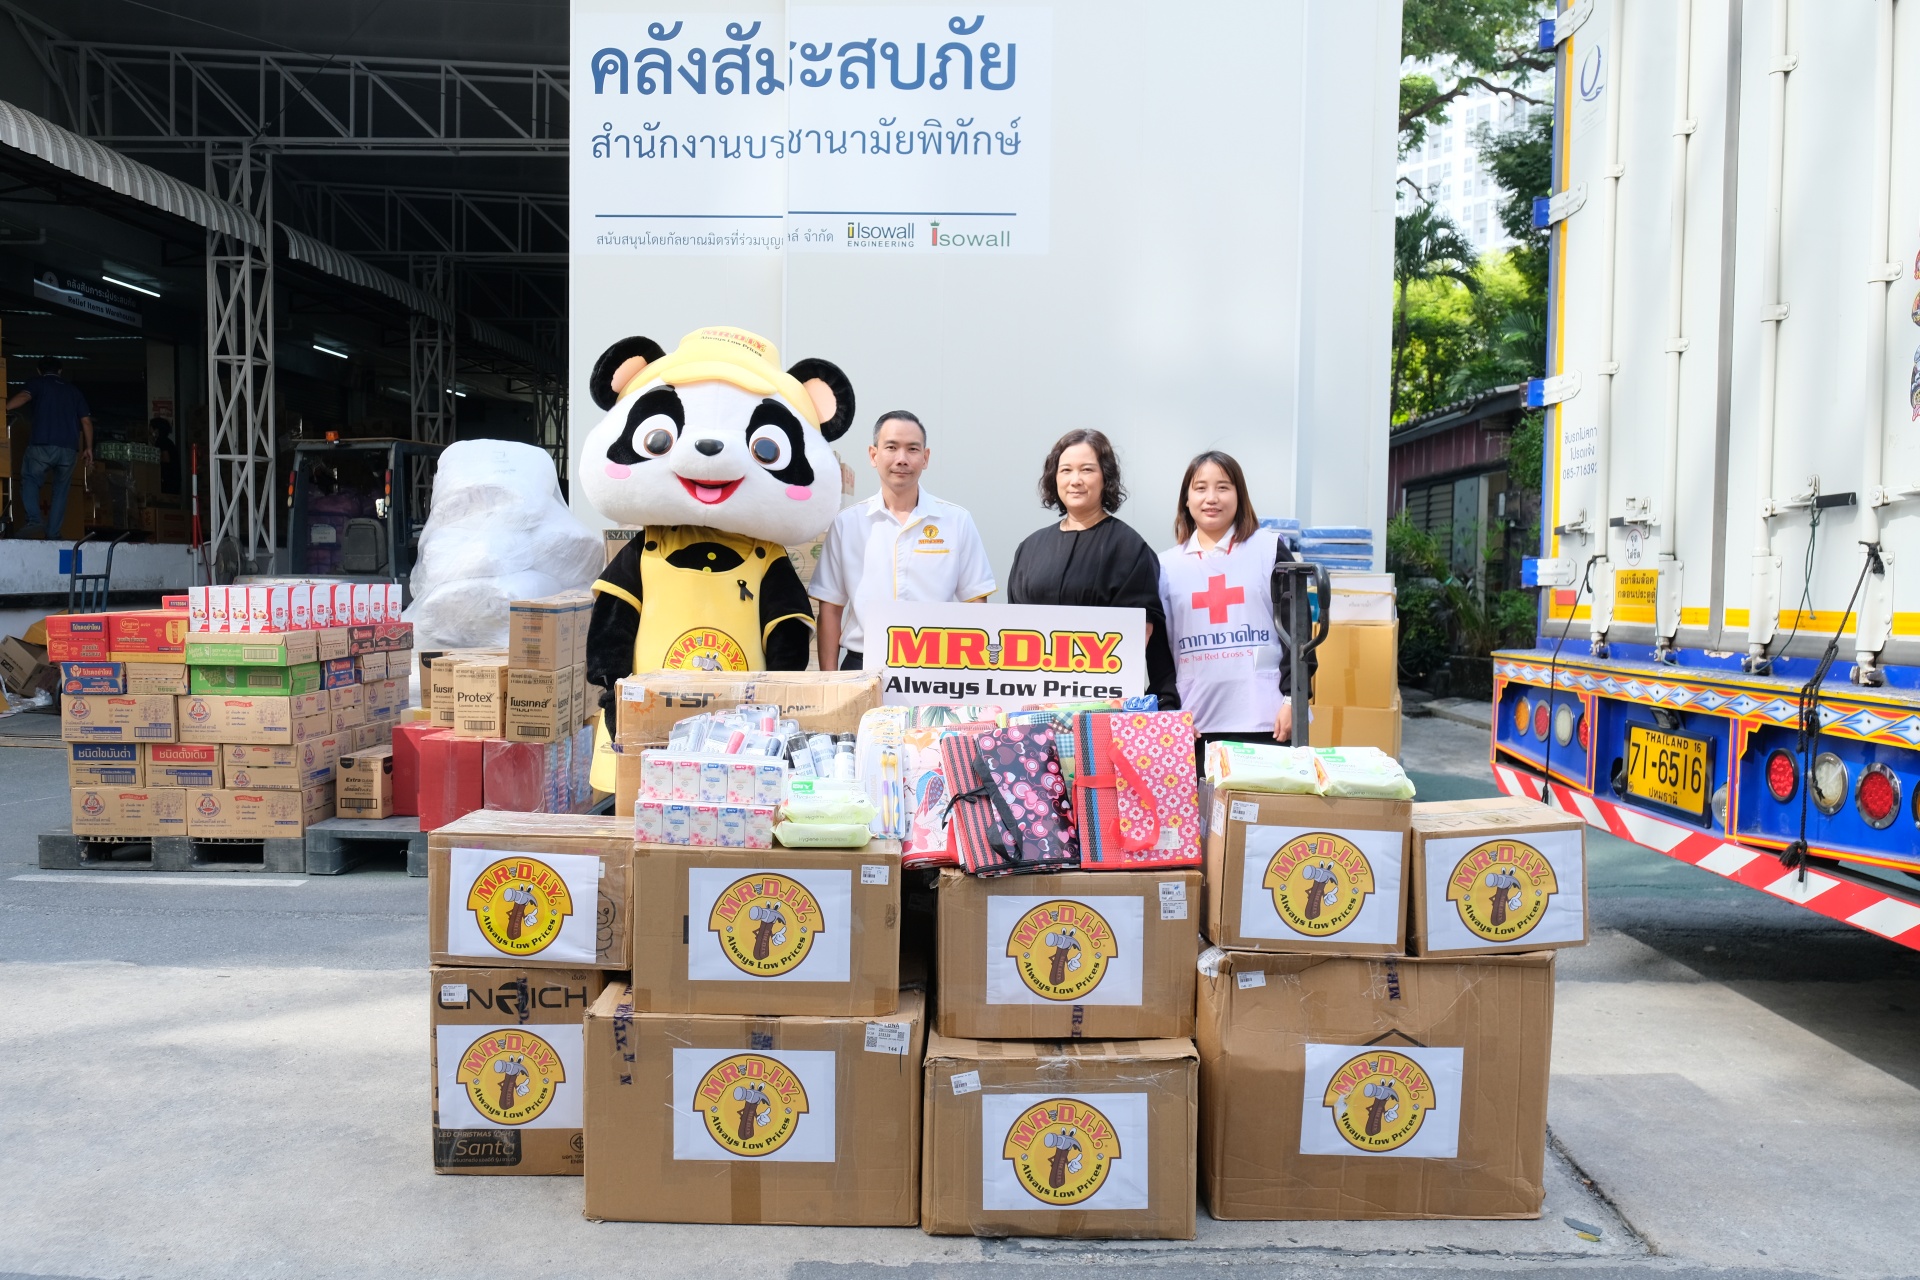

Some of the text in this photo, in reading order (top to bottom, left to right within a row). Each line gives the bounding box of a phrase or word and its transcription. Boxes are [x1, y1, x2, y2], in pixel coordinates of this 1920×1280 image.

[858, 222, 914, 239] Isowall
[847, 240, 915, 248] ENGINEERING
[1204, 652, 1219, 661] Red
[1221, 650, 1244, 659] Cross
[457, 691, 493, 703] Protex
[885, 675, 1122, 699] Always Low Prices
[78, 746, 131, 758] ชนิดไขมันต่ำ
[1645, 732, 1689, 750] THAILAND
[159, 747, 207, 760] ชนิดดั้งเดิม
[1630, 742, 1702, 794] 71-6516
[792, 782, 812, 790] DIY
[1648, 786, 1678, 805] ปทมธานี
[1280, 893, 1357, 930] Always Low Prices
[1465, 900, 1541, 935] Always Low Prices
[483, 915, 556, 950] Always Low Prices
[727, 934, 806, 970] Always Low Prices
[1024, 961, 1100, 994] Always Low Prices
[473, 1086, 549, 1119] Always Low Prices
[711, 1115, 791, 1150] Always Low Prices
[1341, 1111, 1418, 1145] Always Low Prices
[455, 1139, 515, 1156] Santa
[1021, 1163, 1103, 1198] Always Low Prices
